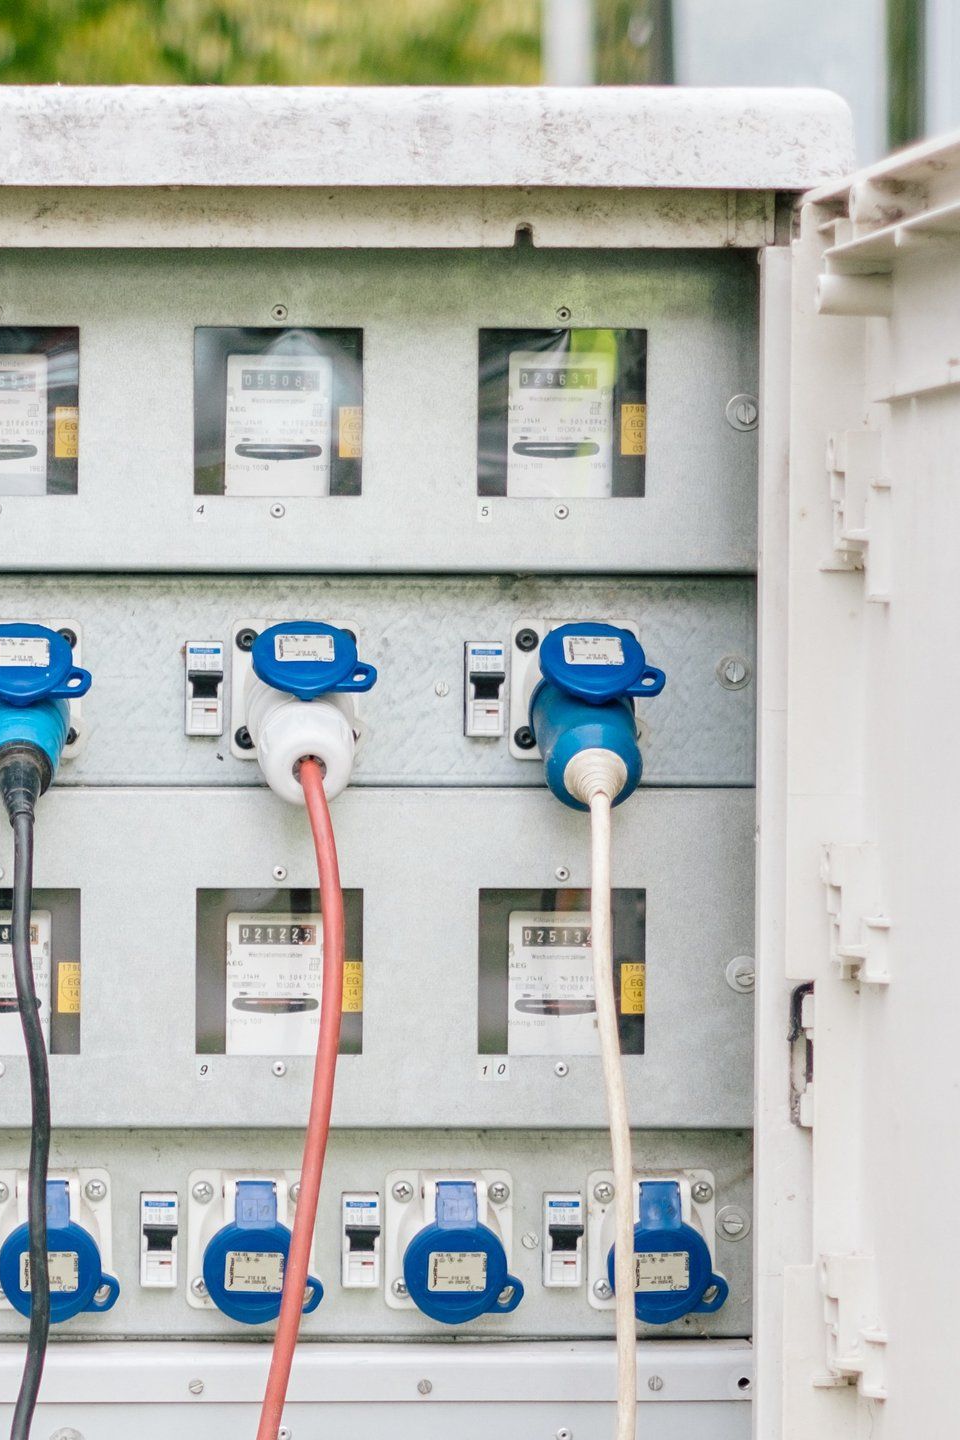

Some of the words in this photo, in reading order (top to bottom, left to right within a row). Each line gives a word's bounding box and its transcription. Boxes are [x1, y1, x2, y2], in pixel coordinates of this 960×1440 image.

[196, 505, 205, 514] 4
[481, 507, 489, 516] 5
[67, 978, 80, 986] EG
[347, 977, 359, 985] EG
[630, 979, 643, 987] EG
[200, 1065, 208, 1075] 9
